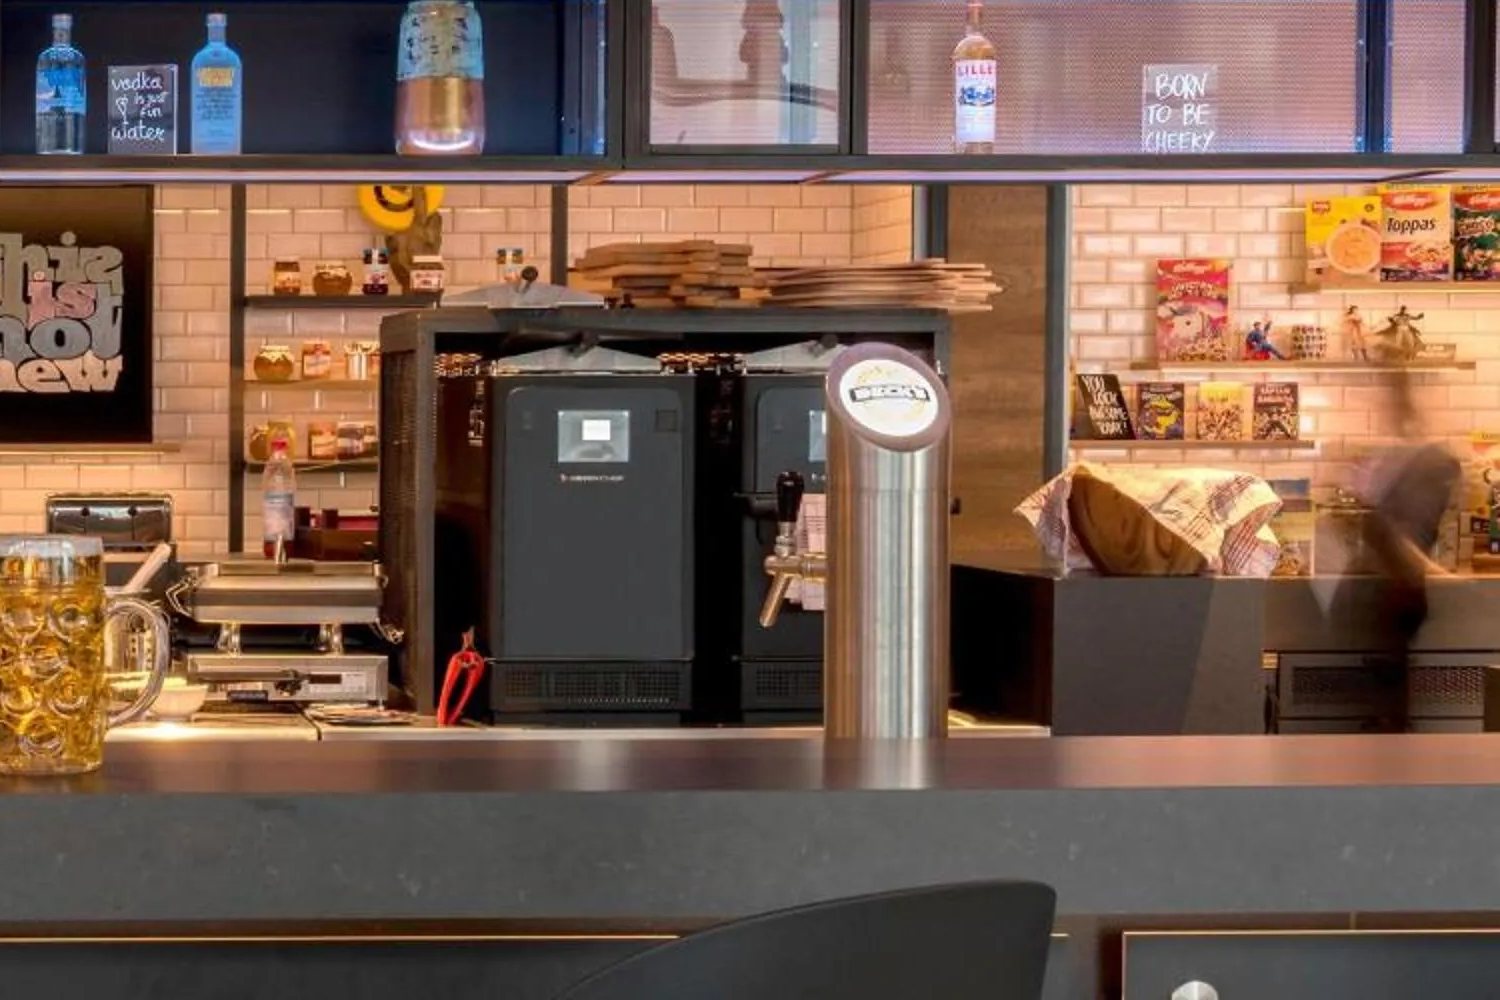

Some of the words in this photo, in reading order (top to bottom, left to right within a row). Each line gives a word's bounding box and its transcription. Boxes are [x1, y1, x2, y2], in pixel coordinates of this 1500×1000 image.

[111, 71, 163, 91] vodka
[1155, 73, 1207, 100] BORN
[1147, 103, 1172, 125] TO
[1183, 103, 1210, 126] BE
[111, 119, 165, 141] water
[1145, 130, 1215, 154] CHEEKY
[1386, 217, 1437, 235] Toppas
[26, 270, 98, 331] is
